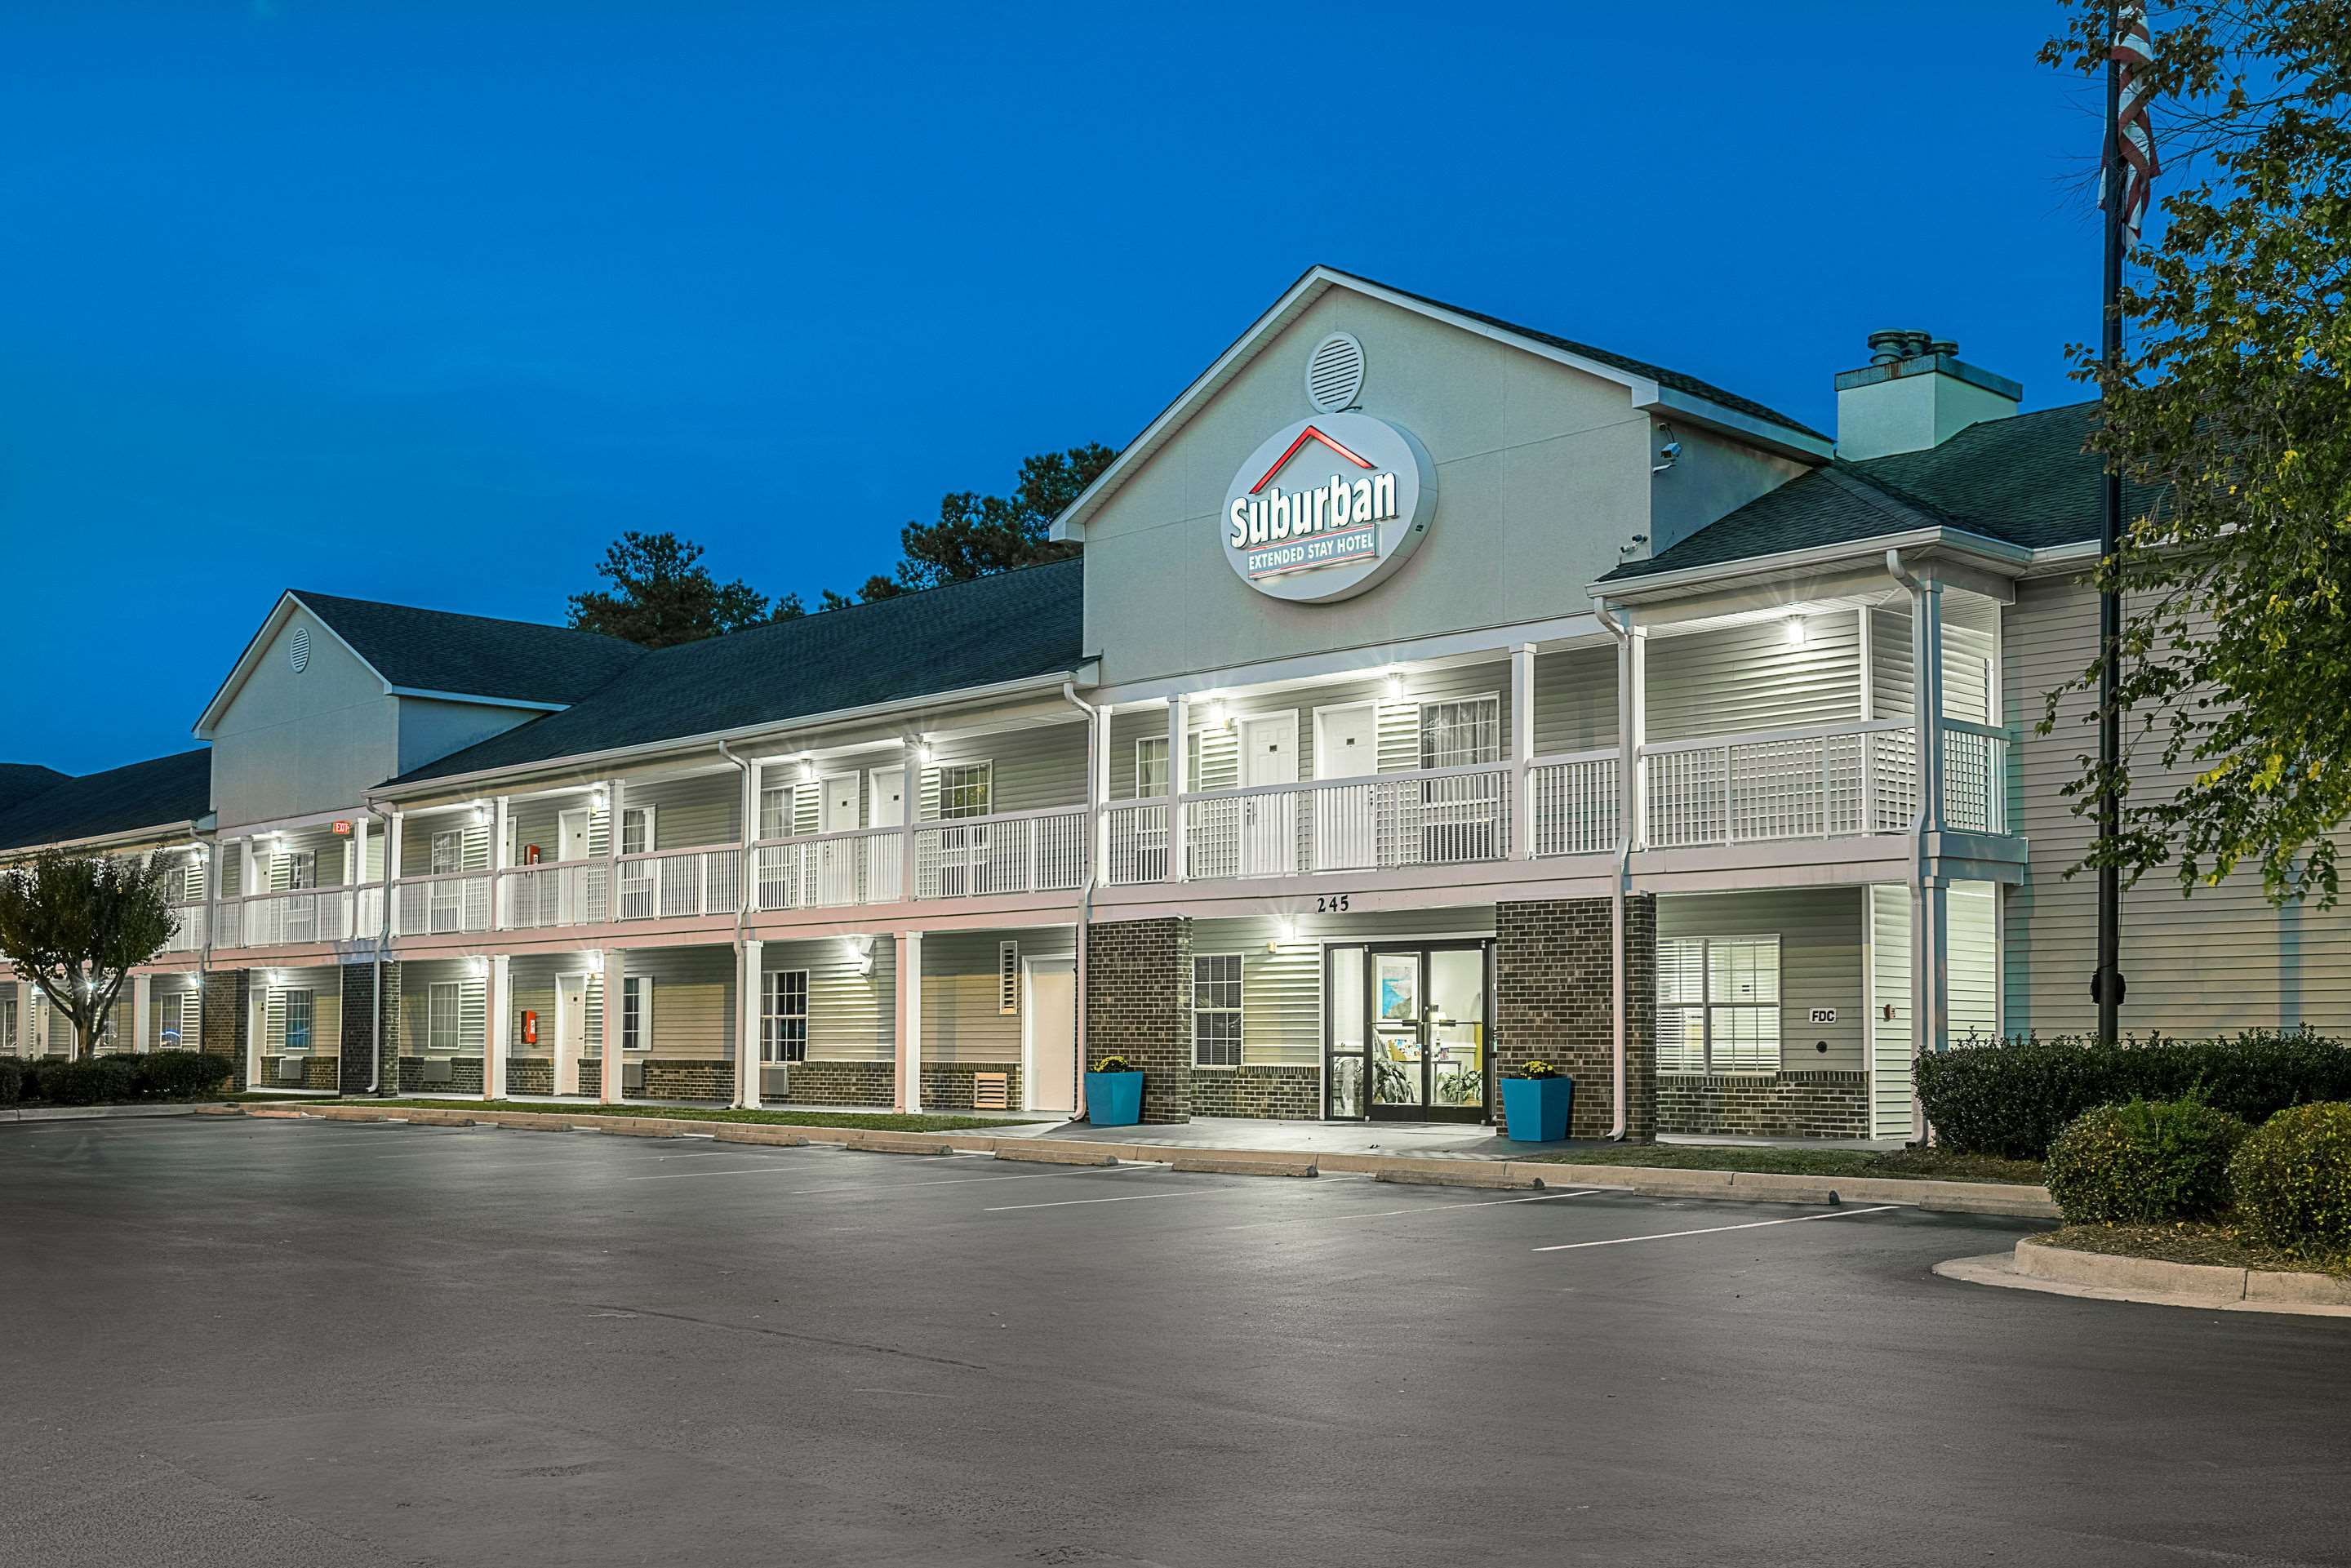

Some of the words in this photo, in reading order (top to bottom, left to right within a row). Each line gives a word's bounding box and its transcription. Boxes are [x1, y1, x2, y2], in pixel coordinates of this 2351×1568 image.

[1229, 471, 1397, 549] Suburban
[1249, 549, 1304, 571] EXTENDED
[1308, 540, 1334, 559] STAY
[1337, 532, 1374, 553] HOTEL
[336, 822, 349, 833] EXIT
[1317, 895, 1349, 913] 245
[1811, 1010, 1835, 1022] FDC
